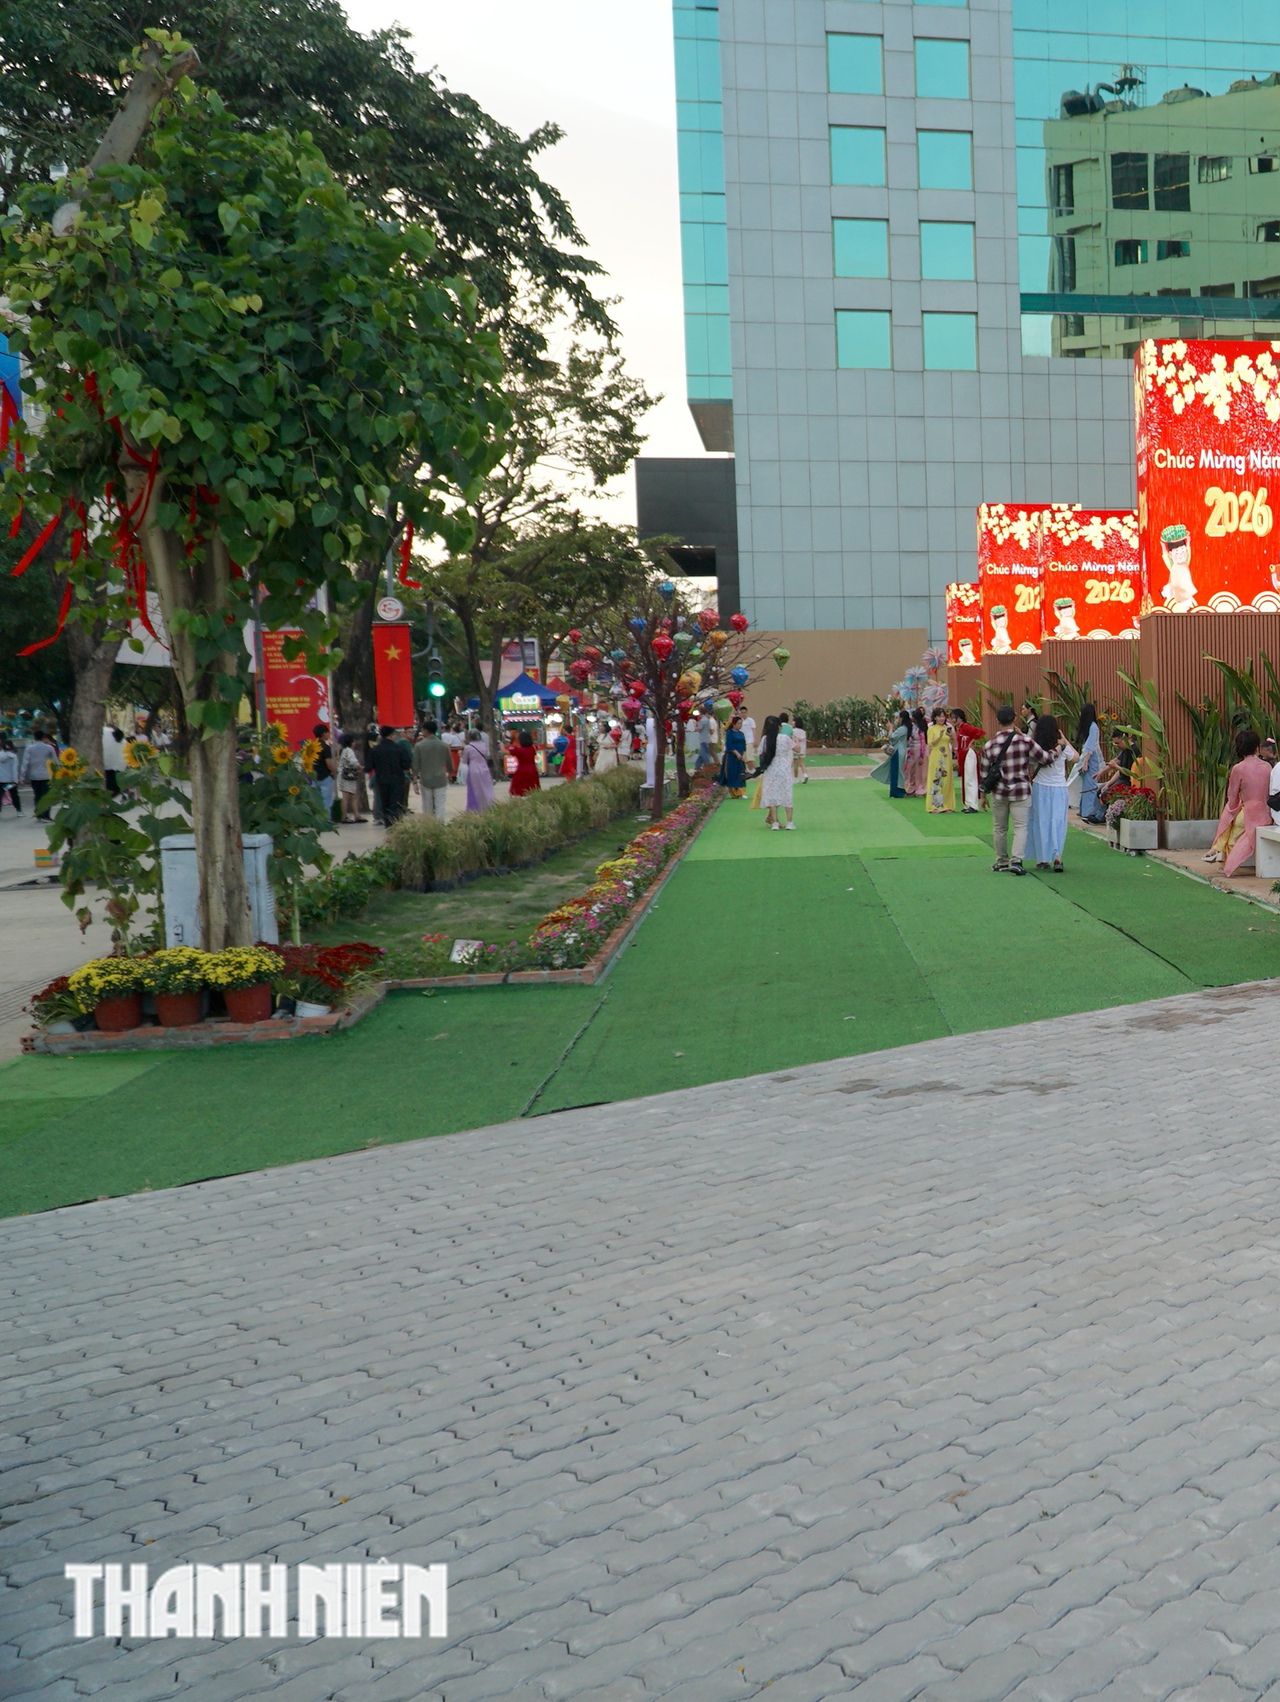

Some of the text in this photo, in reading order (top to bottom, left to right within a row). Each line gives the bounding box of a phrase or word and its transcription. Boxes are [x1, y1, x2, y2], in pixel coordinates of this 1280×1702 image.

[1154, 448, 1195, 469] Chúc
[1199, 449, 1245, 475] Mừng
[1204, 486, 1273, 537] 2026
[986, 562, 1039, 579] Chúc Mừng
[1048, 561, 1078, 572] Chúc
[1081, 561, 1115, 575] Mừng
[1084, 579, 1135, 604] 2026
